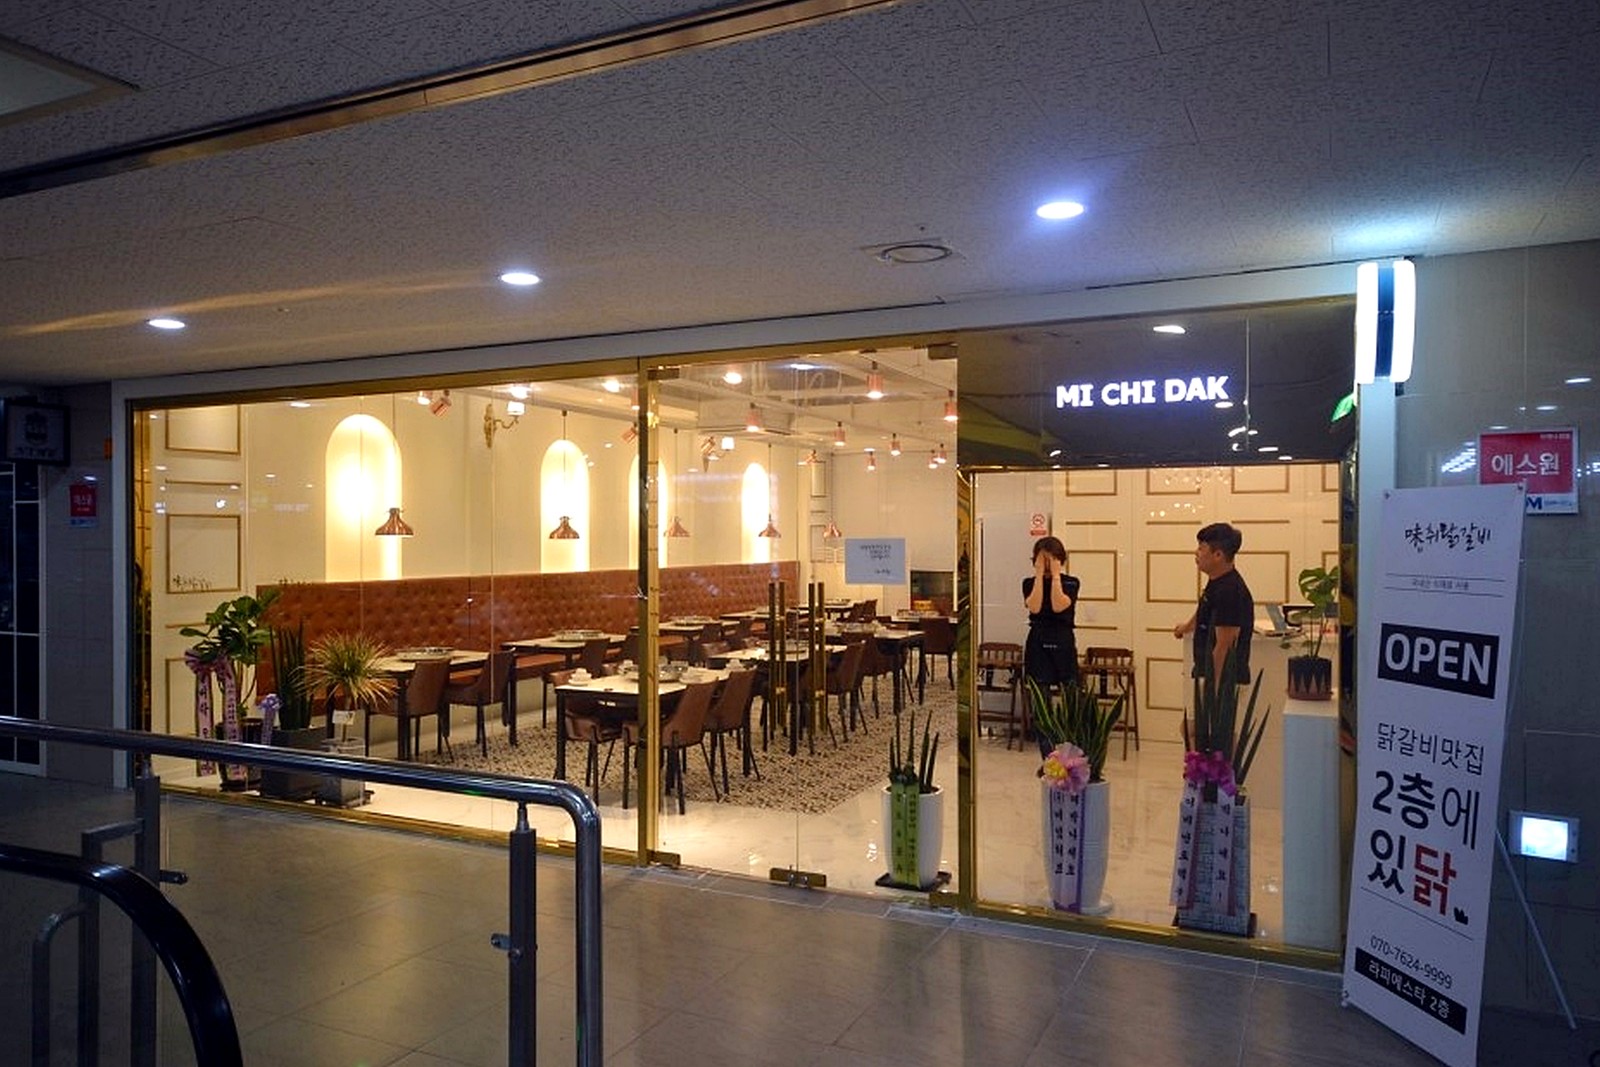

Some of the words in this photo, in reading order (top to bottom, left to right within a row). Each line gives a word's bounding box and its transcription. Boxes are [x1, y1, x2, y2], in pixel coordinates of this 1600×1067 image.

[1056, 383, 1093, 408] MI
[1101, 380, 1156, 406] CHI
[1164, 375, 1229, 402] DAK
[1491, 451, 1560, 476] 에스원
[1385, 633, 1492, 685] OPEN
[1376, 722, 1485, 776] 닭갈비맛집
[1371, 769, 1480, 850] 2층에
[1369, 934, 1453, 990] 070-7624-9999
[1368, 960, 1427, 1007] 라피에스타
[1428, 996, 1451, 1019] 2층
